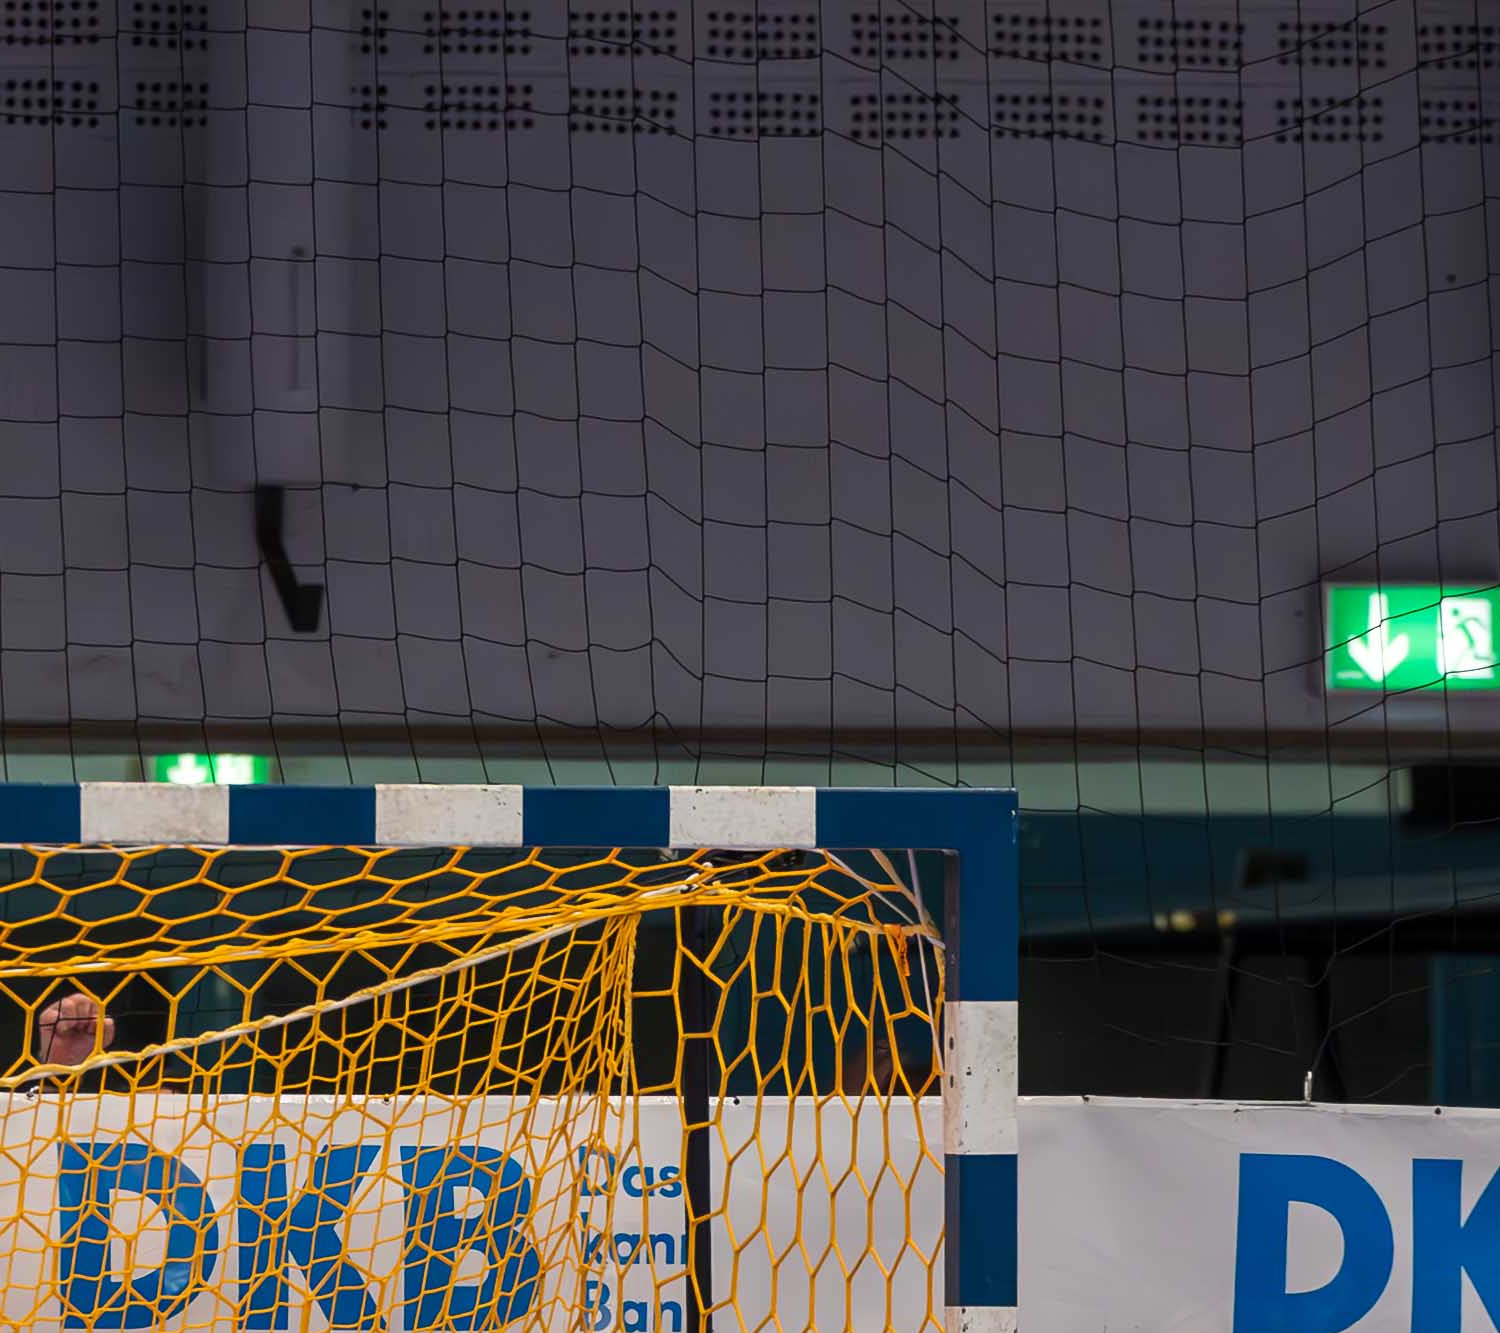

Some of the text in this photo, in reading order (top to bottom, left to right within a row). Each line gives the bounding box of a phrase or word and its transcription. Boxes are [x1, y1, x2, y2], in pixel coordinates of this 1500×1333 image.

[578, 1145, 683, 1198] Das
[57, 1142, 545, 1332] DKB
[580, 1211, 688, 1265] kan
[579, 1279, 683, 1333] Ban
